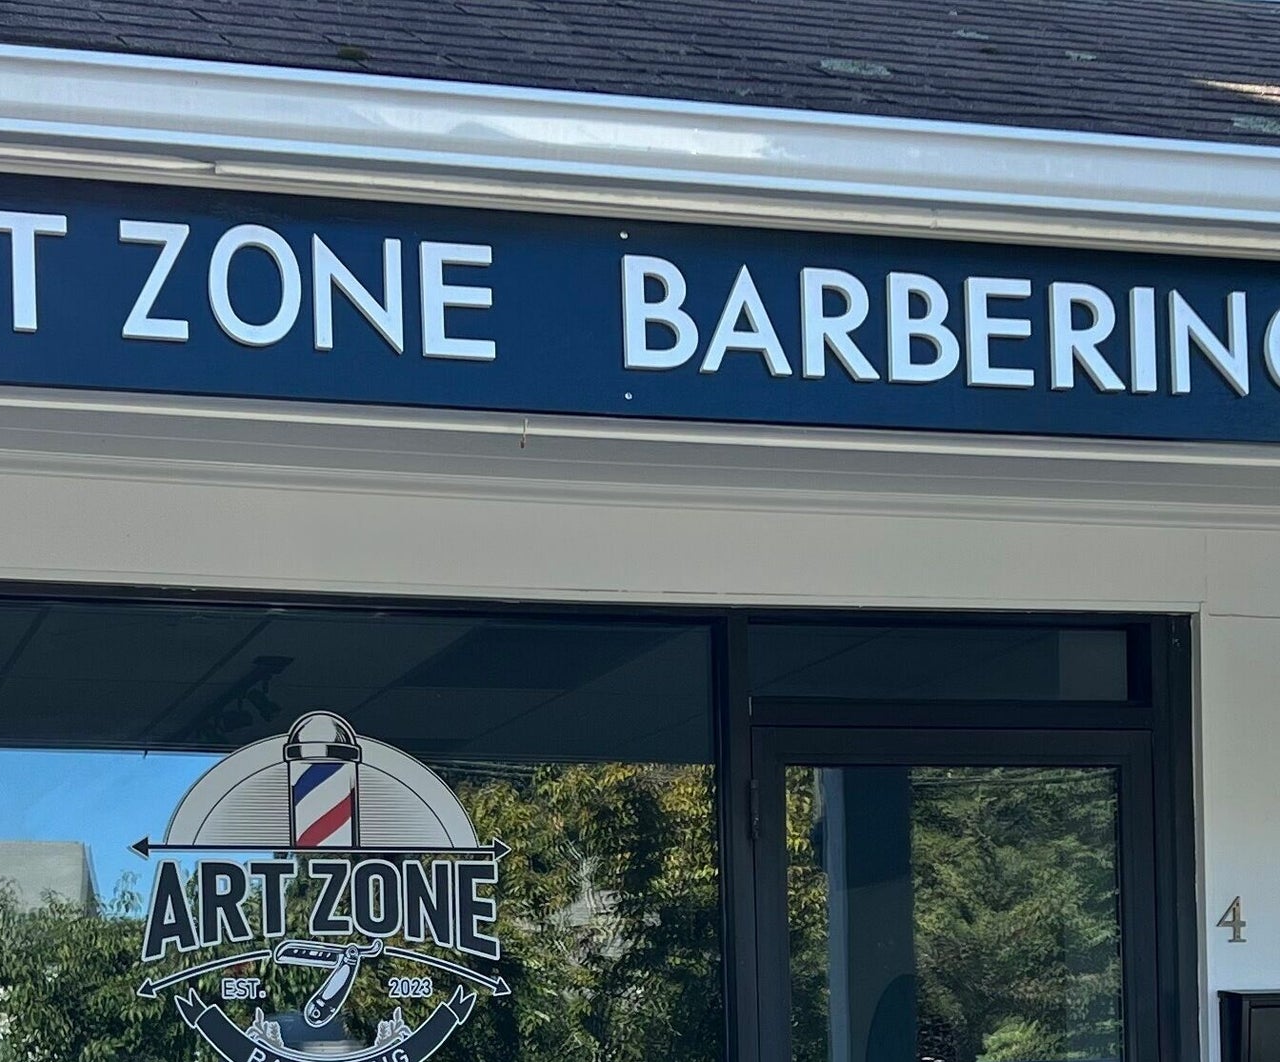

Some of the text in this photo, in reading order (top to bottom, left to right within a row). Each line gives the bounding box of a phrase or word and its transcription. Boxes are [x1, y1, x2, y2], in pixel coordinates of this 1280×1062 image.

[119, 218, 497, 362] ZONE
[141, 859, 501, 962] ART ZONE
[1216, 895, 1247, 942] 4
[221, 978, 433, 999] EST. 2023
